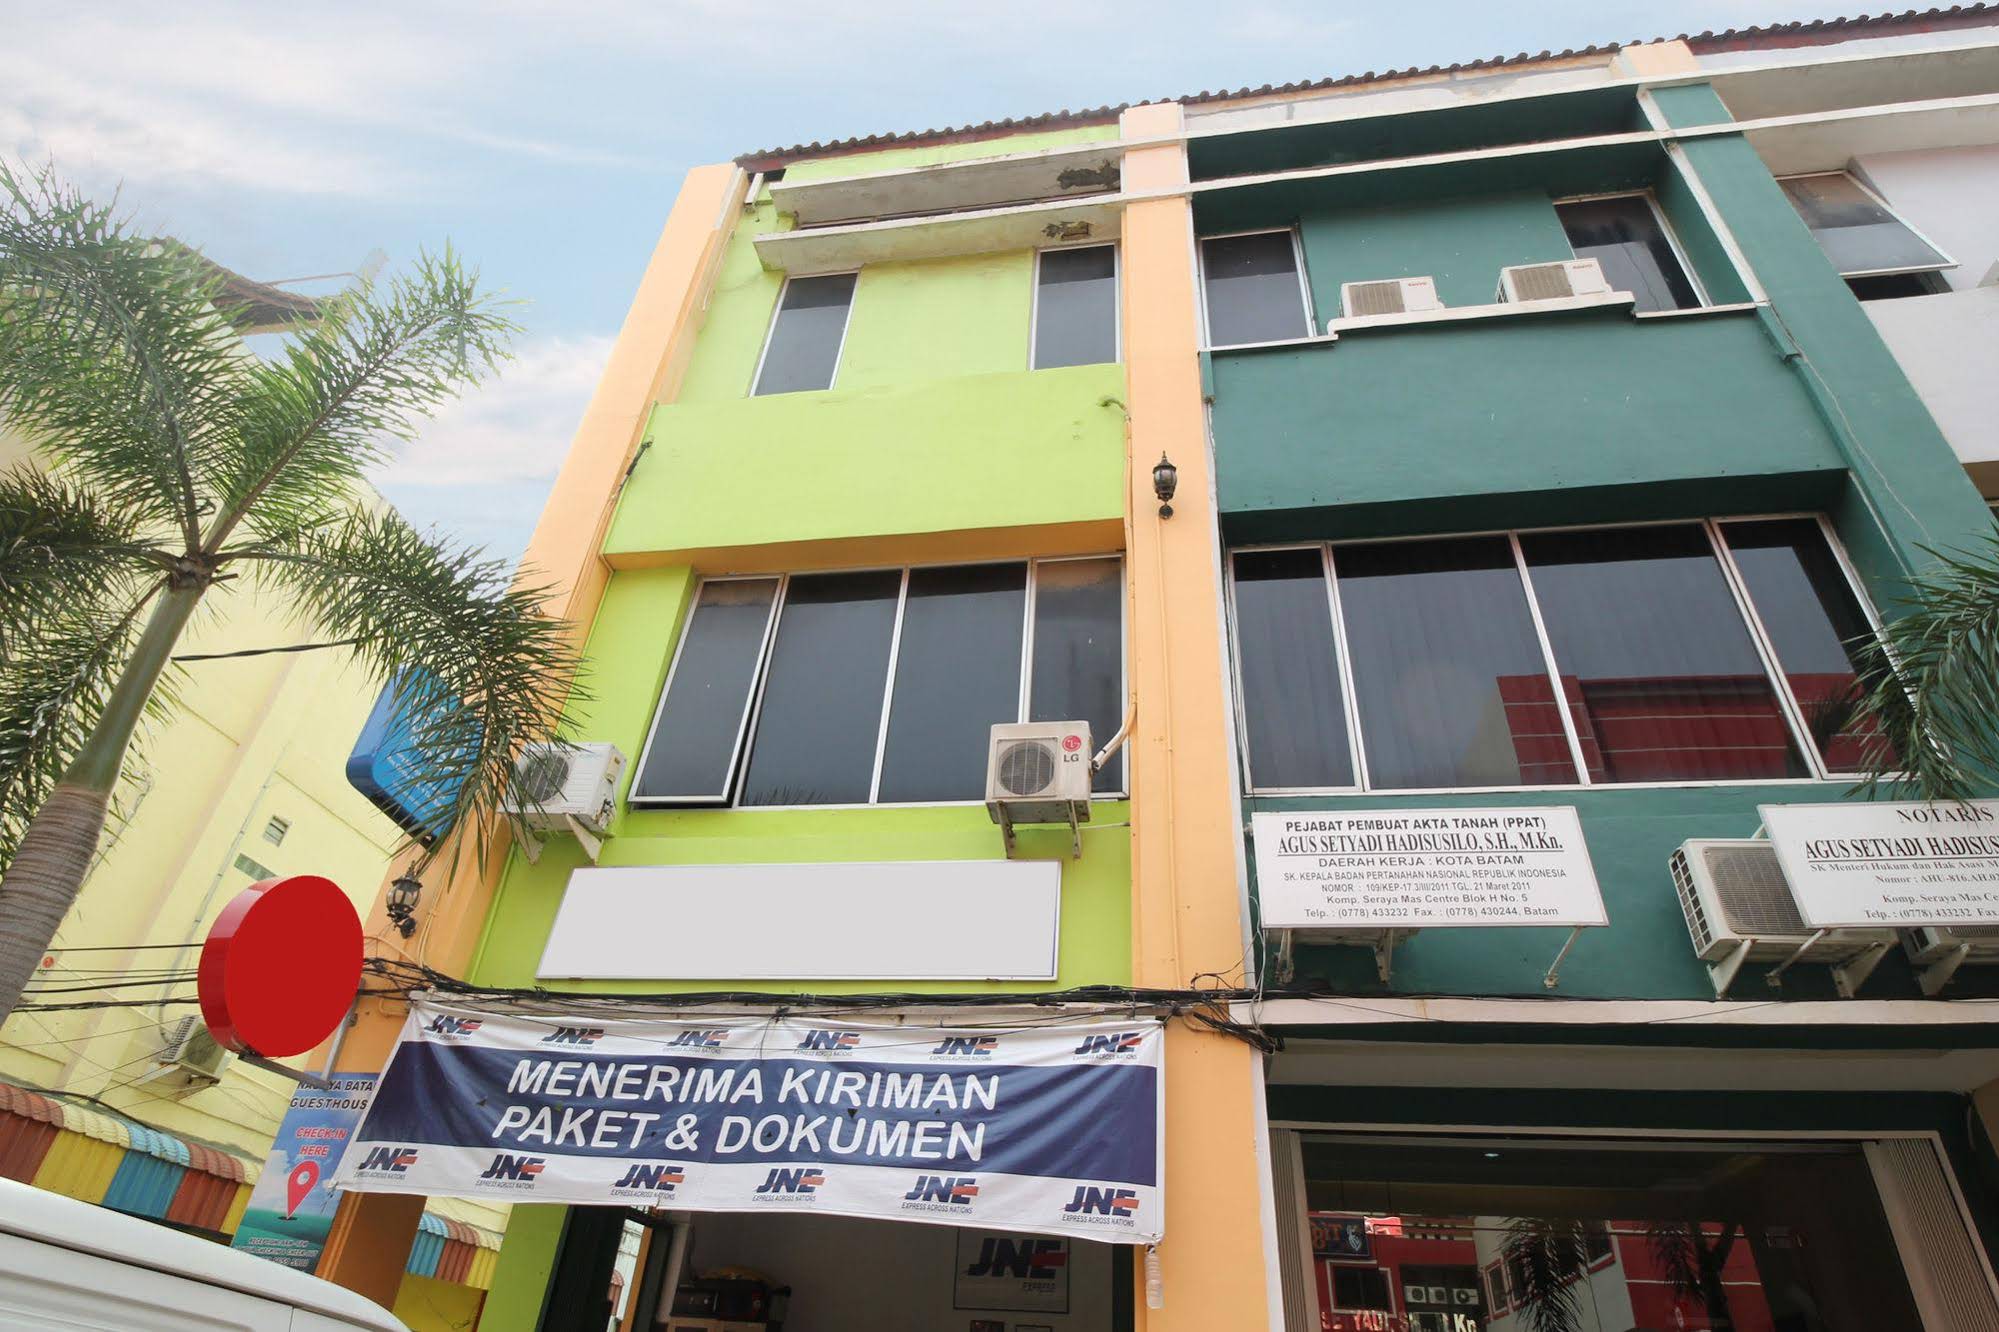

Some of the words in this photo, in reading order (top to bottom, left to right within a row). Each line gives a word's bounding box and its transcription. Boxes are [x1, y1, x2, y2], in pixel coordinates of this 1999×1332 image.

[1064, 754, 1079, 762] LG
[1896, 807, 1994, 823] NOTARIS
[1286, 821, 1343, 832] PEJABAT
[1348, 819, 1409, 830] PEMBUAT
[1413, 819, 1448, 829] AKTA
[1452, 818, 1498, 828] TANAH
[1503, 817, 1546, 830] (PPAT)
[1279, 836, 1318, 853] AGUS
[1320, 834, 1383, 852] SETYADI
[1386, 833, 1483, 852] HADISUSILO,
[1484, 832, 1518, 851] S.H.,
[1520, 832, 1563, 849] M.Kn.
[1805, 839, 1851, 859] AGUS
[1851, 838, 1926, 858] SETYADI
[1319, 858, 1375, 867] DAERAH
[1380, 857, 1425, 866] KERJA
[1435, 856, 1473, 865] KOTA
[1476, 855, 1525, 865] BATAM
[1810, 864, 1827, 872] SK
[1827, 863, 1870, 871] Menteri
[1871, 862, 1910, 870] Hukum
[1933, 861, 1955, 869] Hak
[1300, 872, 1333, 880] KEPALA
[1335, 871, 1365, 880] BADAN
[1366, 871, 1424, 880] PERTANAHAN
[1426, 870, 1470, 878] NASIONAL
[1472, 869, 1518, 878] REPUBLIK
[1518, 869, 1566, 878] INDONESIA
[1875, 874, 1911, 883] Nomor
[1321, 884, 1354, 892] NOMOR
[1486, 882, 1509, 891] Maret
[1512, 882, 1531, 890] 2011
[1326, 896, 1360, 905] Komp.
[1363, 895, 1398, 904] Seraya
[1400, 895, 1421, 903] Mas
[1425, 894, 1459, 903] Centre
[1462, 894, 1486, 903] Blok
[1489, 894, 1498, 902] H
[1883, 895, 1918, 904] Komp.
[1920, 894, 1957, 903] Seraya
[1958, 893, 1981, 901] Mas
[1304, 908, 1329, 919] Telp.
[1524, 906, 1559, 915] Batam
[424, 1015, 483, 1035] JNE
[541, 1026, 605, 1045] JNE
[667, 1030, 730, 1047] JNE
[797, 1029, 862, 1050] JNE
[1074, 1033, 1143, 1054] JNE
[932, 1037, 999, 1055] JNE
[298, 1080, 341, 1091] NAYA
[345, 1081, 377, 1092] BATA
[507, 1059, 763, 1104] MENERIMA
[778, 1068, 999, 1110] KIRIMAN
[491, 1105, 660, 1149] PAKET
[664, 1113, 699, 1151] &
[715, 1114, 985, 1162] DOKUMEN
[300, 1145, 330, 1156] HERE
[358, 1146, 418, 1171] JNE
[480, 1154, 546, 1181] JNE
[614, 1164, 685, 1191] JNE
[756, 1168, 826, 1193] JNE
[904, 1175, 980, 1204] JNE
[901, 1202, 926, 1211] EXPRESS
[927, 1204, 949, 1213] ACROSS
[949, 1206, 973, 1215] NATIONS
[1064, 1186, 1140, 1217] JNE
[1063, 1214, 1088, 1223] EXPRESS
[1088, 1217, 1111, 1225] ACROSS
[1111, 1219, 1135, 1227] NATIONS
[967, 1237, 1066, 1279] JNE
